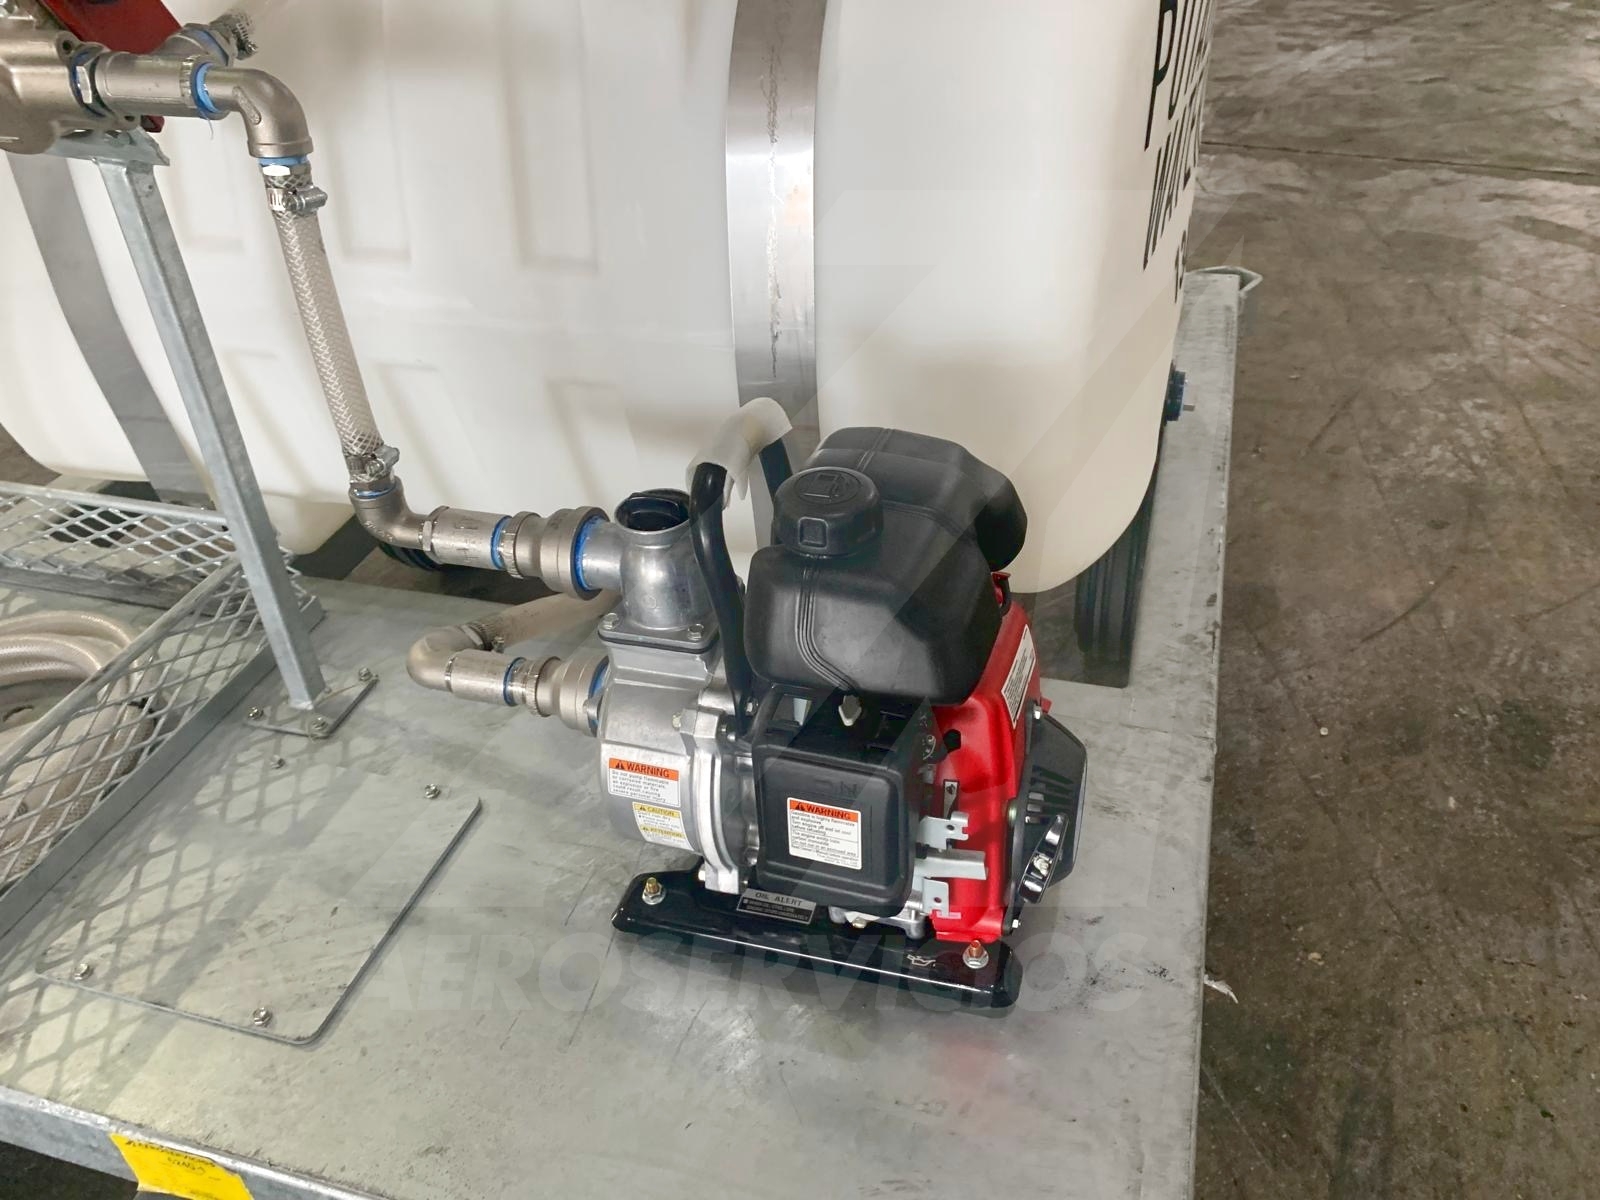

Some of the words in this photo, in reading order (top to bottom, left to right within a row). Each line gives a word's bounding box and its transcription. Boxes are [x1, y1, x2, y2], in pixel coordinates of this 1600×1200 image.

[626, 762, 670, 778] WARNING
[806, 804, 851, 821] WARNING
[774, 895, 803, 907] ALERT
